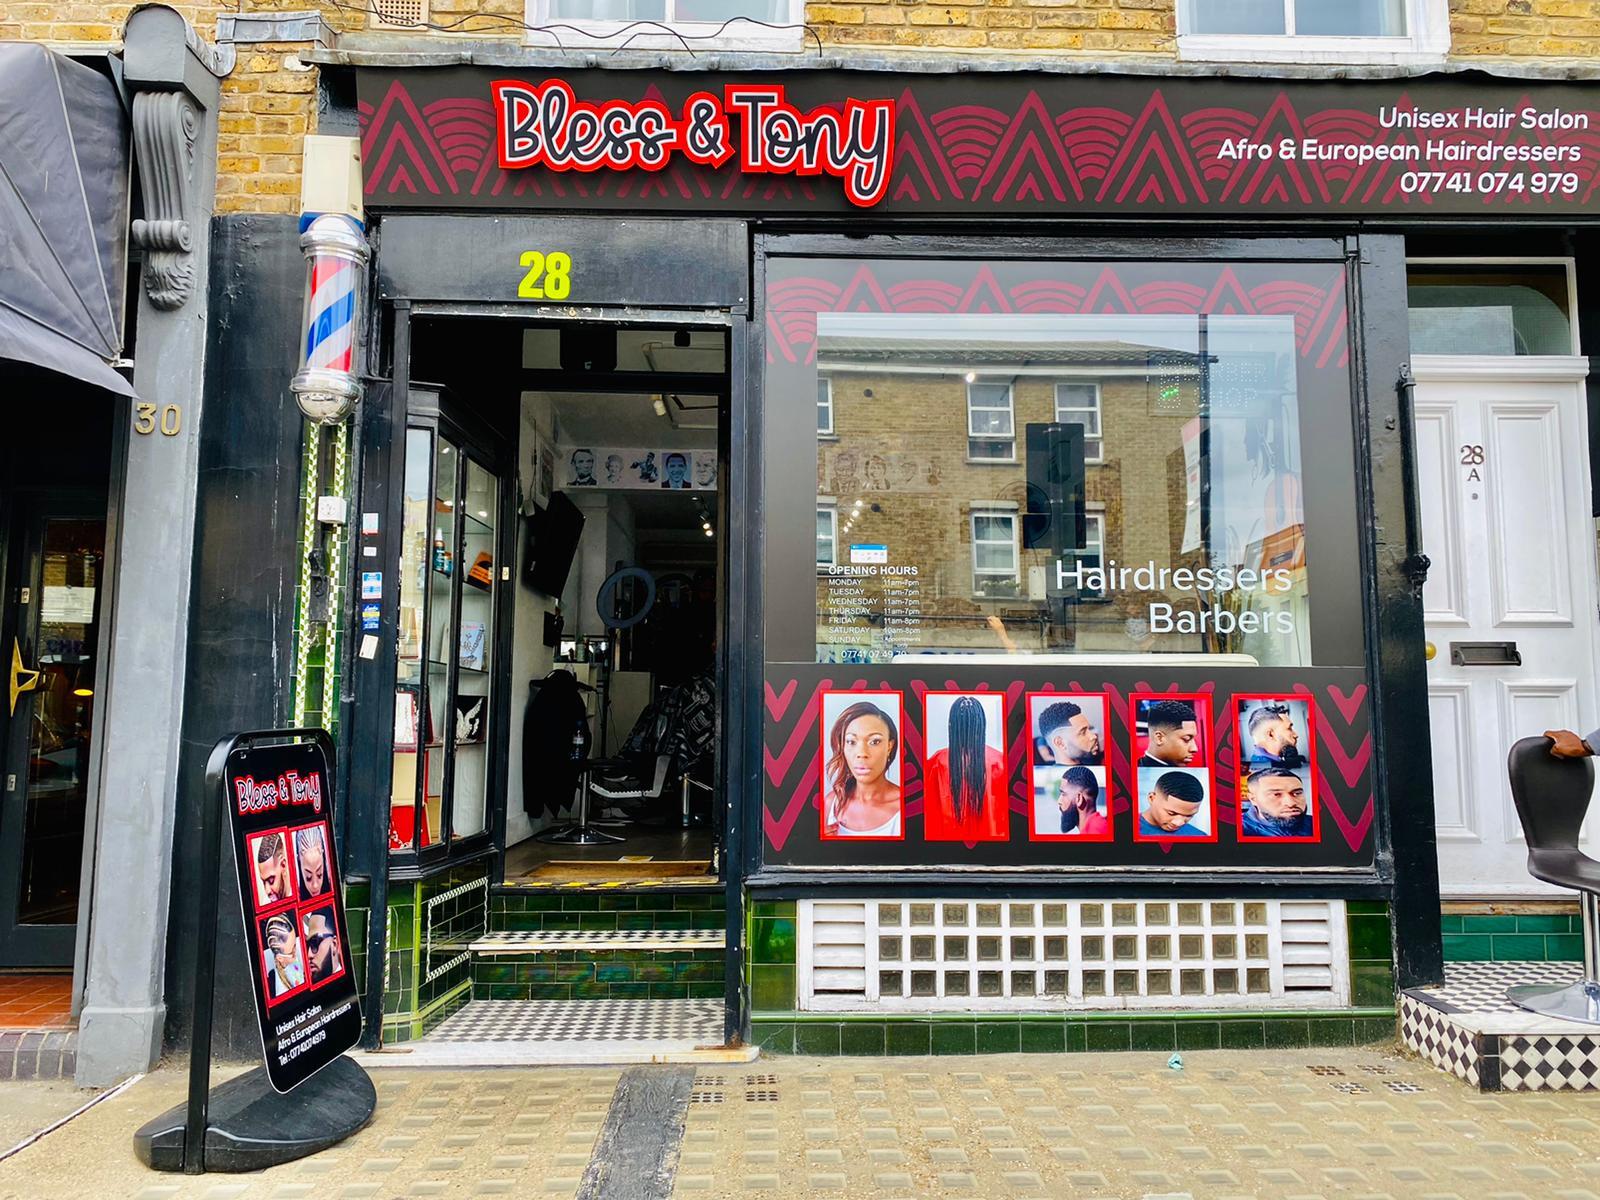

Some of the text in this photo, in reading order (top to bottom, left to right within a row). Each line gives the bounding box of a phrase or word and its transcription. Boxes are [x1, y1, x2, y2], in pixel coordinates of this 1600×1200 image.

[1378, 106, 1589, 130] Unisex Hair Salon
[497, 83, 889, 201] Bless & Tony
[1217, 138, 1581, 165] Afro & European Hairdressers
[1400, 171, 1579, 194] 07741 074 979
[517, 250, 572, 299] 28
[134, 402, 182, 437] 30
[1460, 444, 1485, 465] 28
[1466, 467, 1481, 482] A
[828, 566, 919, 576] OPENING HOURS
[1055, 559, 1293, 592] Hairdressers
[883, 588, 920, 596] 11am-7pm
[883, 598, 920, 606] 11am-7pm
[828, 607, 871, 615] THURSDAY
[1149, 602, 1294, 634] Barbers
[236, 772, 321, 811] Bless & Tony
[275, 1004, 322, 1036] Unisex Hair Salon
[277, 1038, 292, 1052] Afro
[295, 1019, 321, 1041] European
[321, 1003, 351, 1025] Hairdressers
